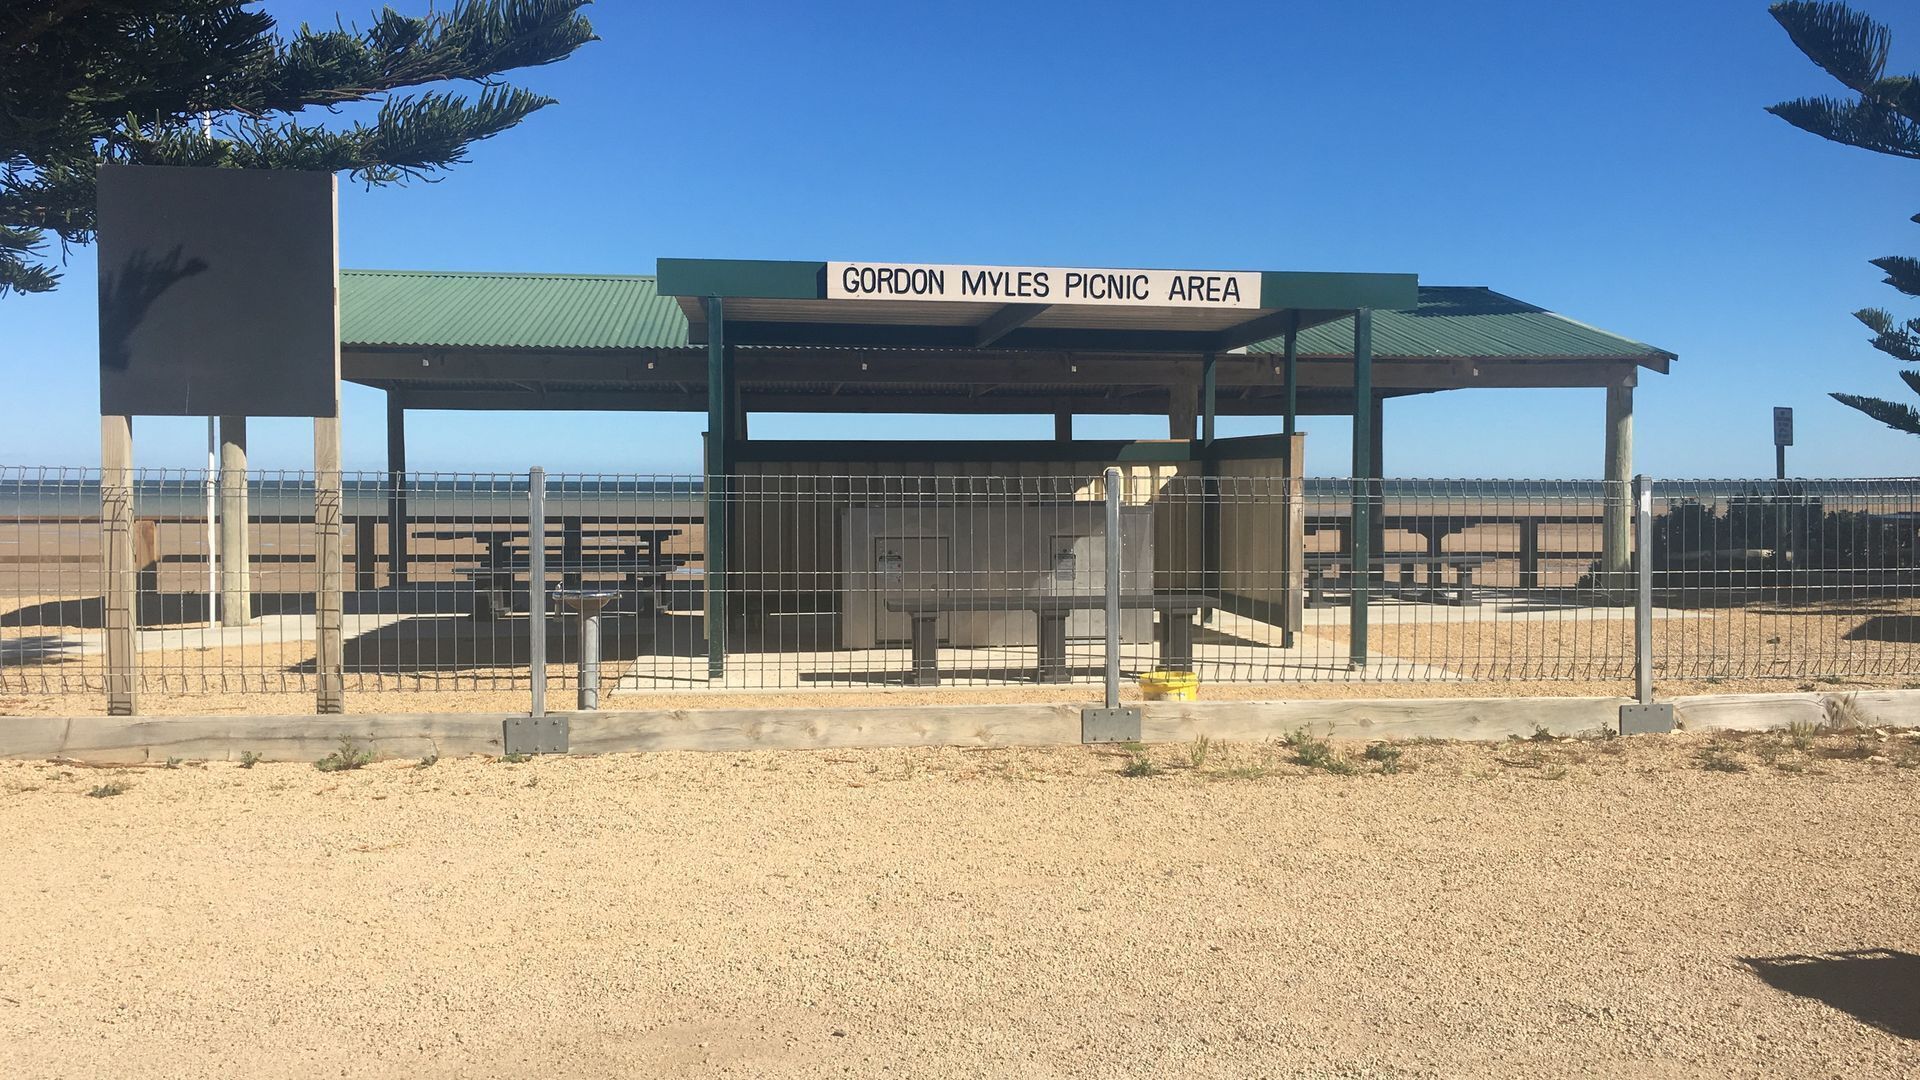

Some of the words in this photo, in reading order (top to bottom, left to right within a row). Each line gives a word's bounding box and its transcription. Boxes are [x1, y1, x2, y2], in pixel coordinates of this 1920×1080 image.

[843, 267, 944, 295] GORDON
[962, 270, 1050, 298] MYLES
[1065, 273, 1149, 300] PICNIC
[1168, 276, 1241, 302] AREA
